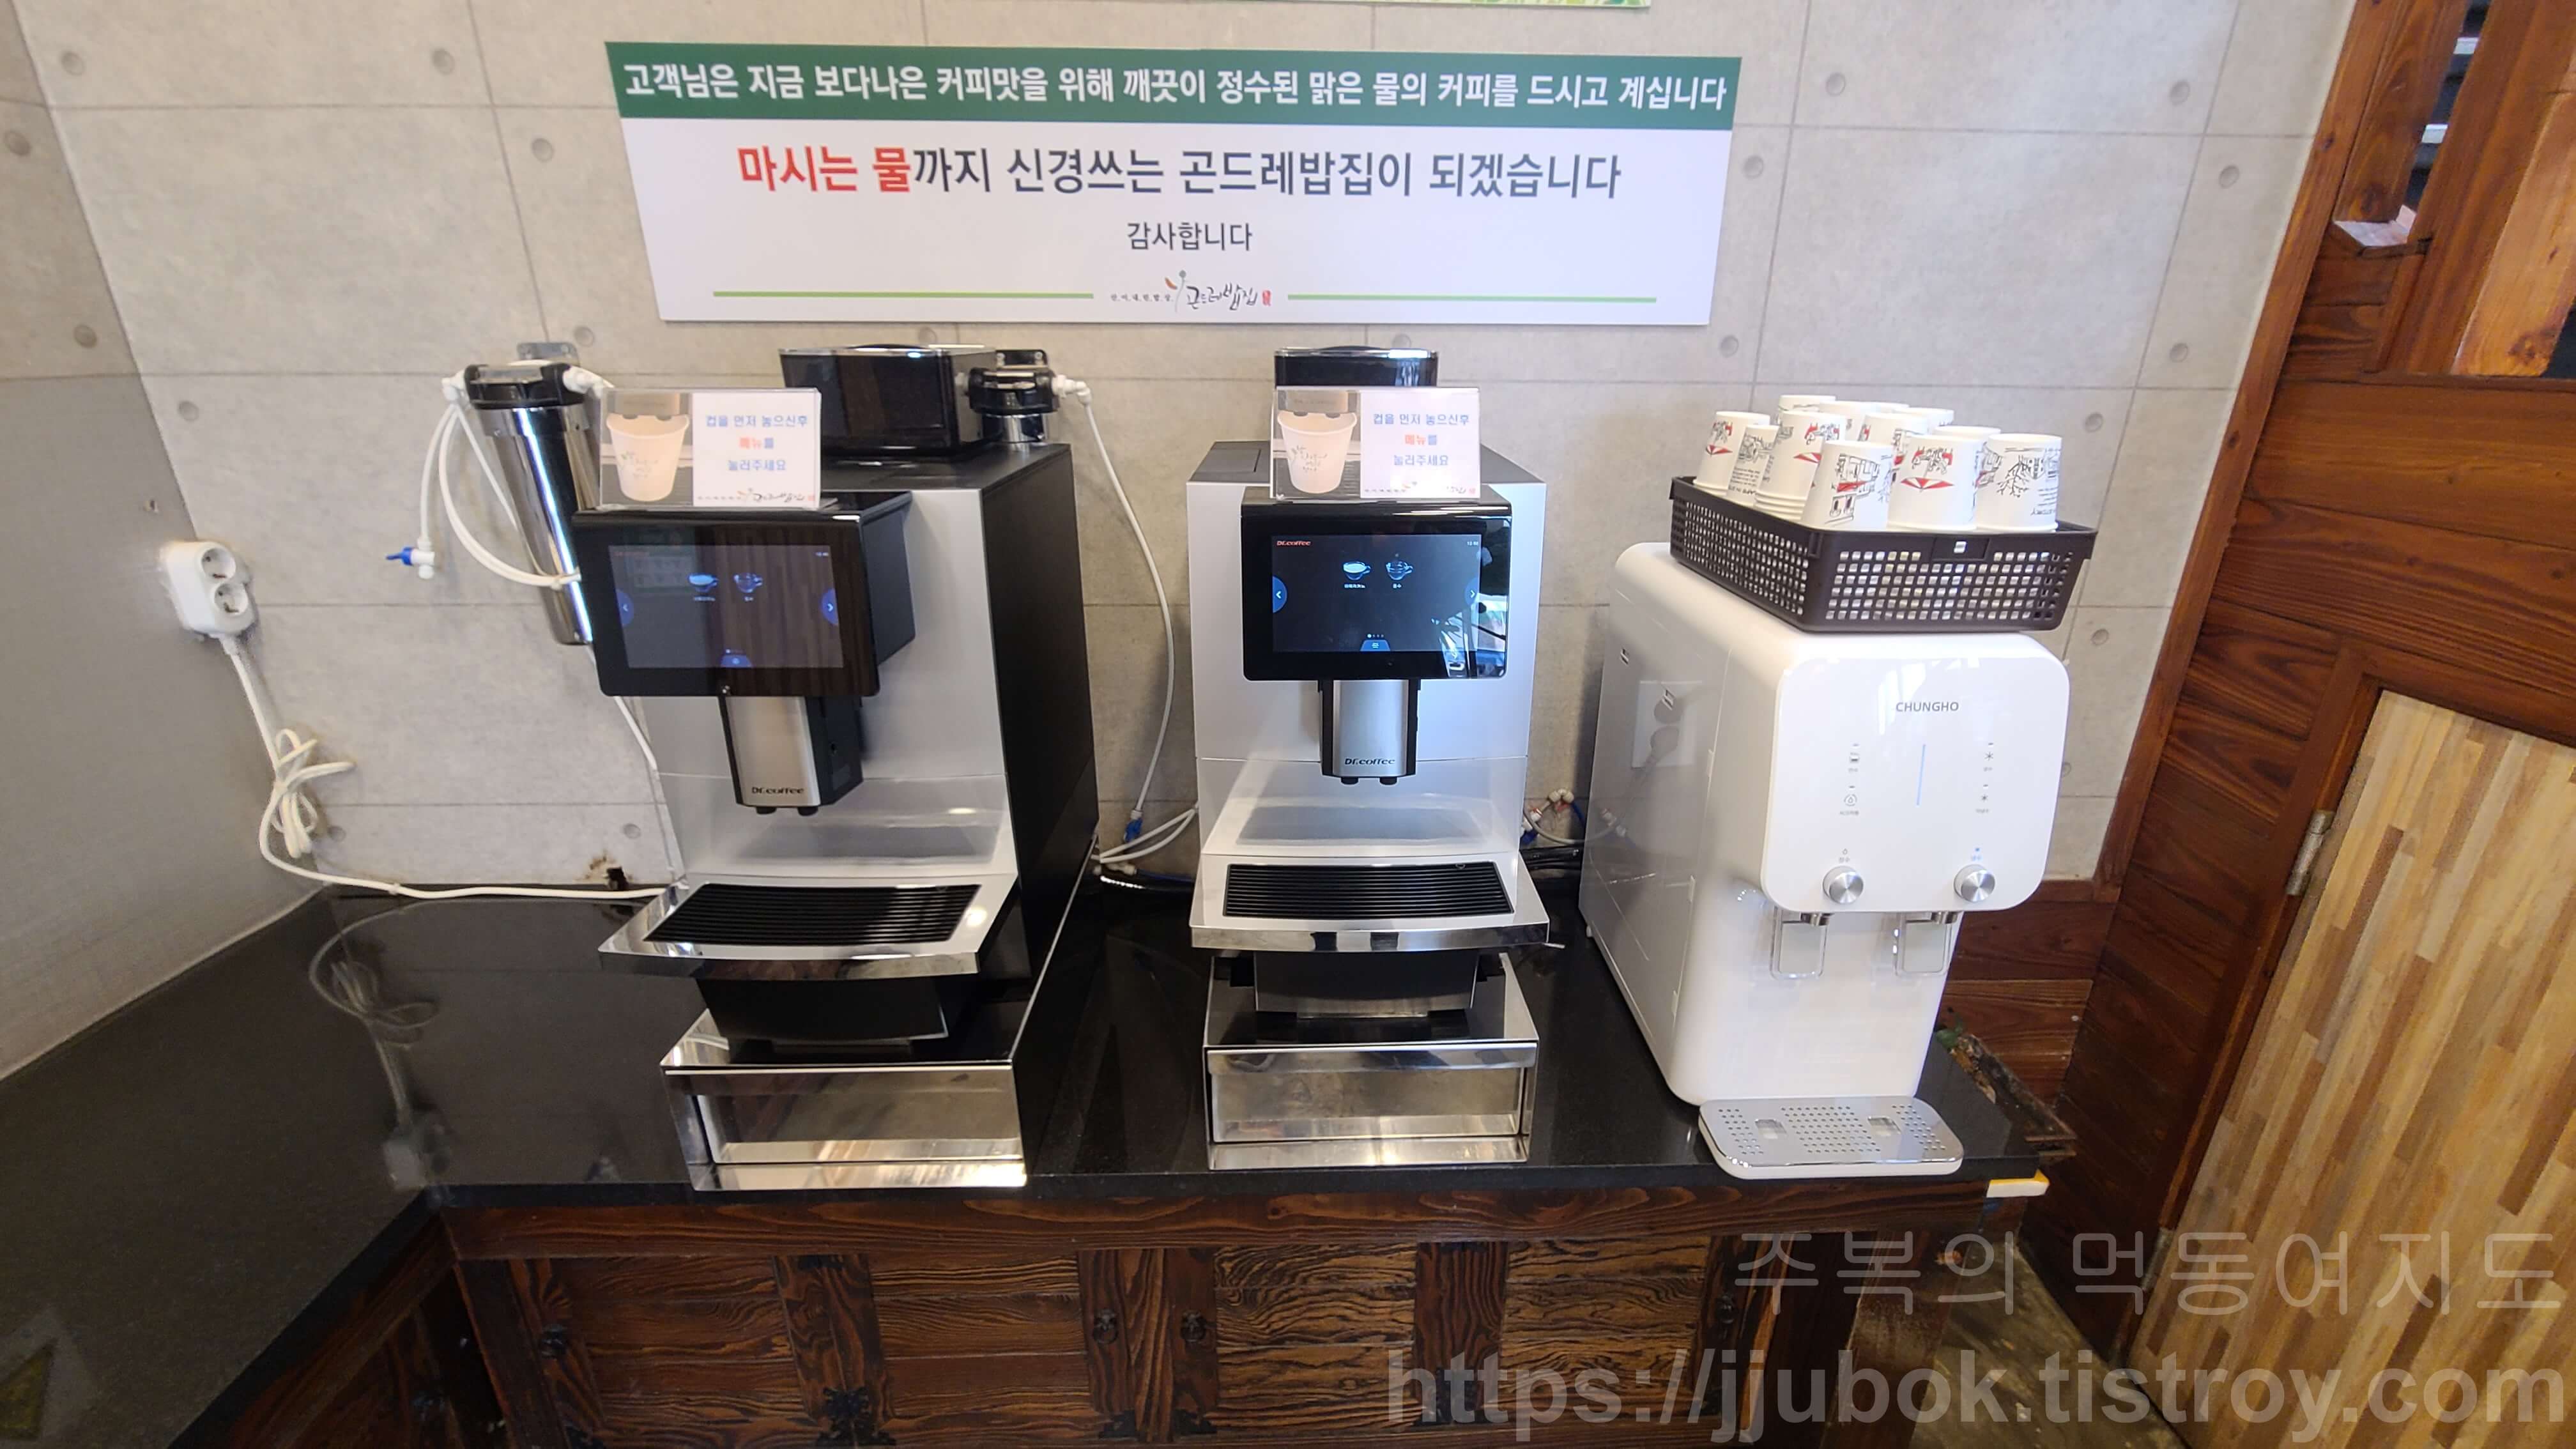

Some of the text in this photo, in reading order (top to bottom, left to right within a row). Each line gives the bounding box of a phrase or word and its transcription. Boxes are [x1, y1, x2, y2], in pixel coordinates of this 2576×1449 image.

[625, 65, 1727, 110] 고객님은 지금 보다나은 커피맛을 위해 깨끗이 정수된 맑은 물의 커피를 드시고 계십니다
[738, 146, 1621, 199] 마시는 물까지 신경쓰는 곤드레밥집이 되겠습니다
[1128, 222, 1253, 251] 감사합니다
[1186, 283, 1258, 311] 곤드레밥집
[707, 415, 728, 427] 컵을
[734, 415, 756, 427] 먼저
[1374, 413, 1394, 425] 컵을
[1400, 413, 1420, 425] 먼저
[728, 459, 786, 471] 눌러주세요
[1393, 454, 1449, 466] 눌러주세요
[1896, 701, 1960, 712] CHUNGHO
